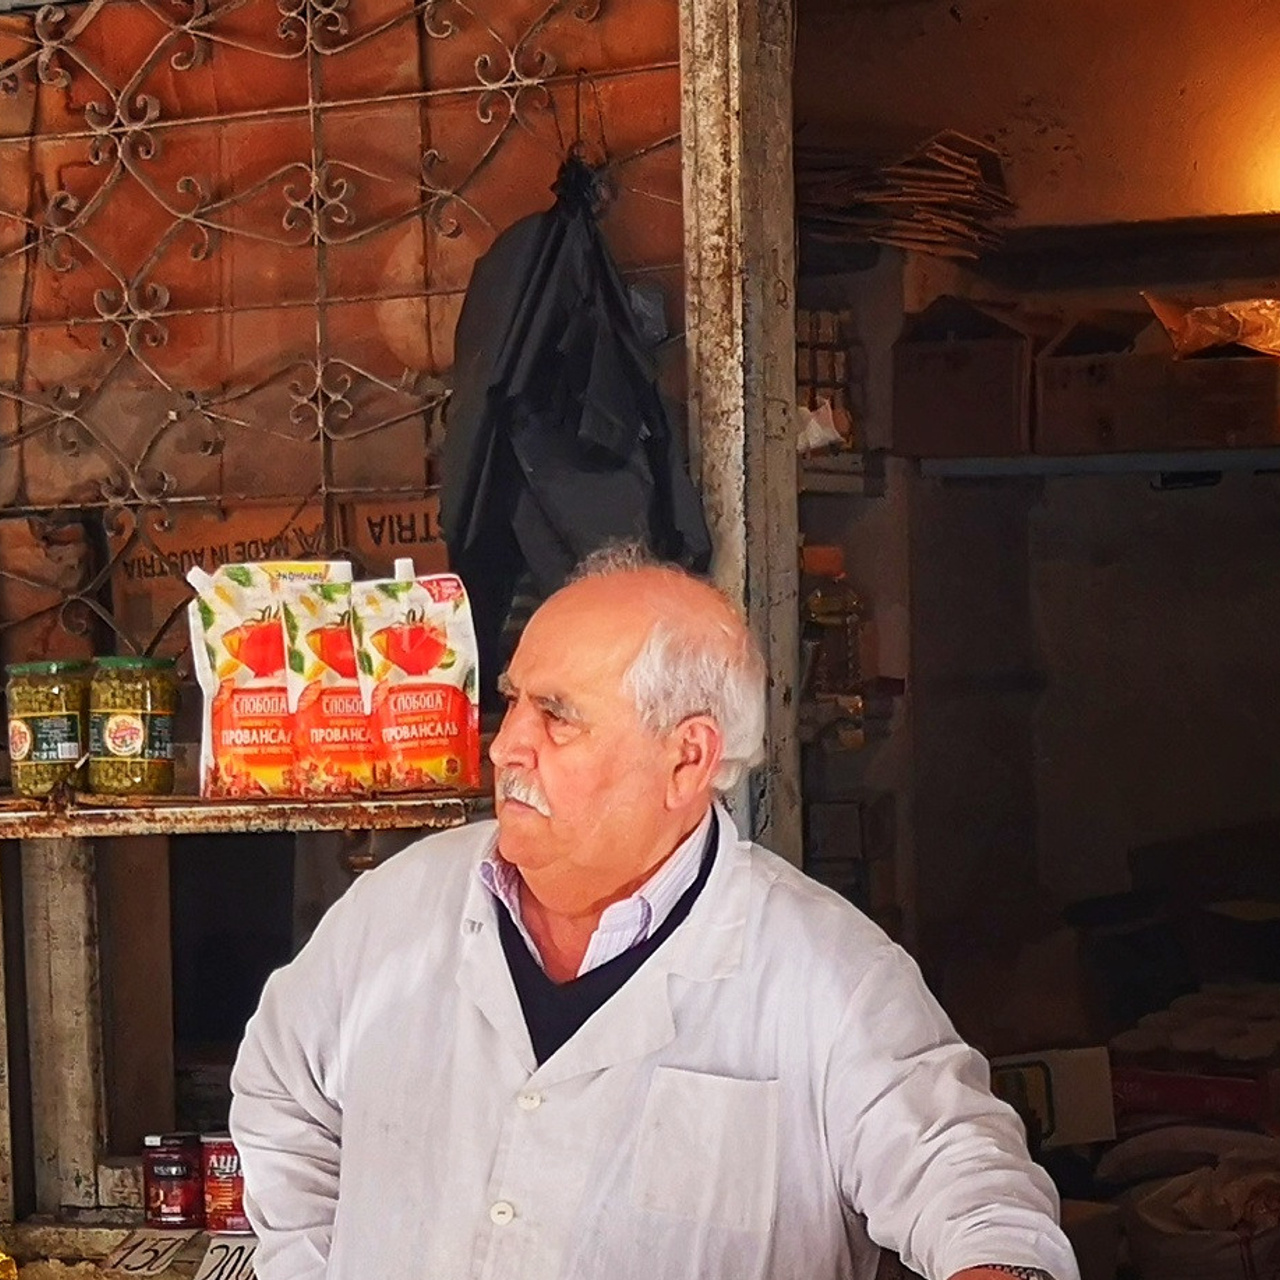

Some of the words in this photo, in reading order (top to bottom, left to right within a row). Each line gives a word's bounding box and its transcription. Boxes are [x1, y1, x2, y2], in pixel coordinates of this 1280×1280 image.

[367, 511, 438, 546] TRIA
[390, 692, 444, 713] СЛОБОДА
[382, 721, 459, 745] ПРОВАНСАЛЬ
